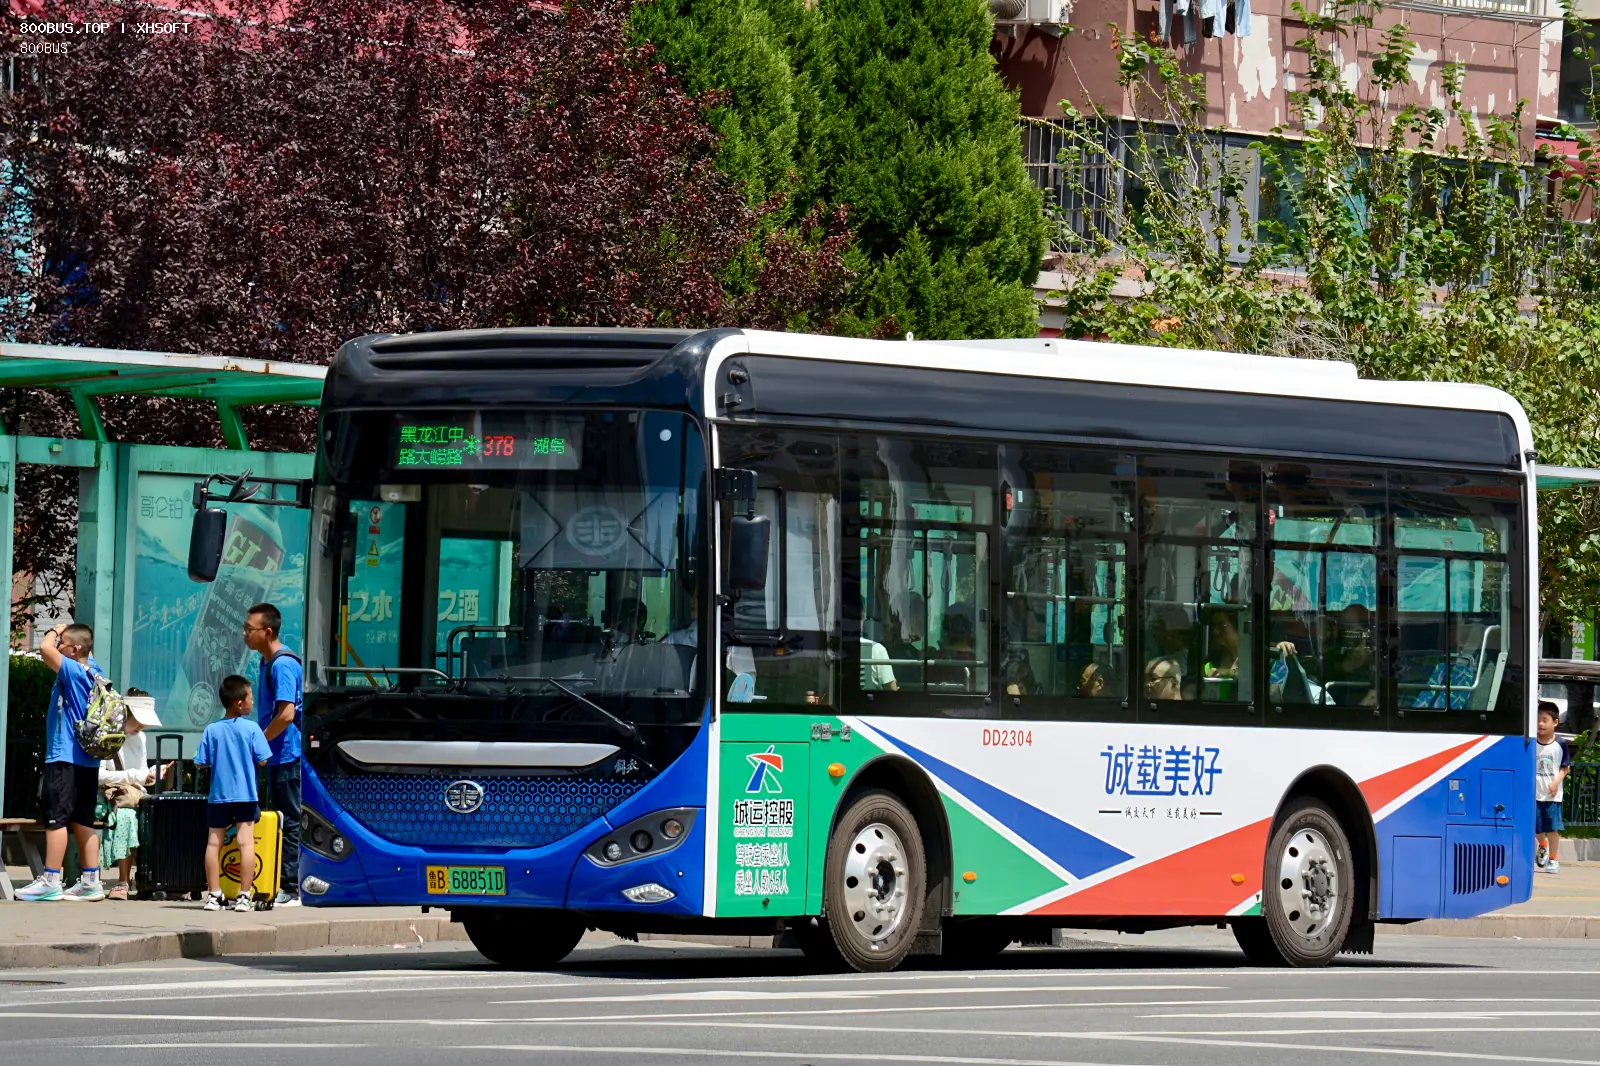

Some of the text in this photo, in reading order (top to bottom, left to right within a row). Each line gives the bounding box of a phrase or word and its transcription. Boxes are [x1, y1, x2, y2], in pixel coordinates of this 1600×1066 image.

[400, 426, 464, 443] 黑龙江中
[483, 436, 514, 456] 378
[140, 495, 184, 519] 哥仑铂
[339, 589, 394, 623] 之水
[982, 728, 1033, 747] DD2304
[1100, 743, 1223, 797] 诚载美好
[734, 799, 794, 826] 城运控股
[767, 827, 793, 838] HOLDING
